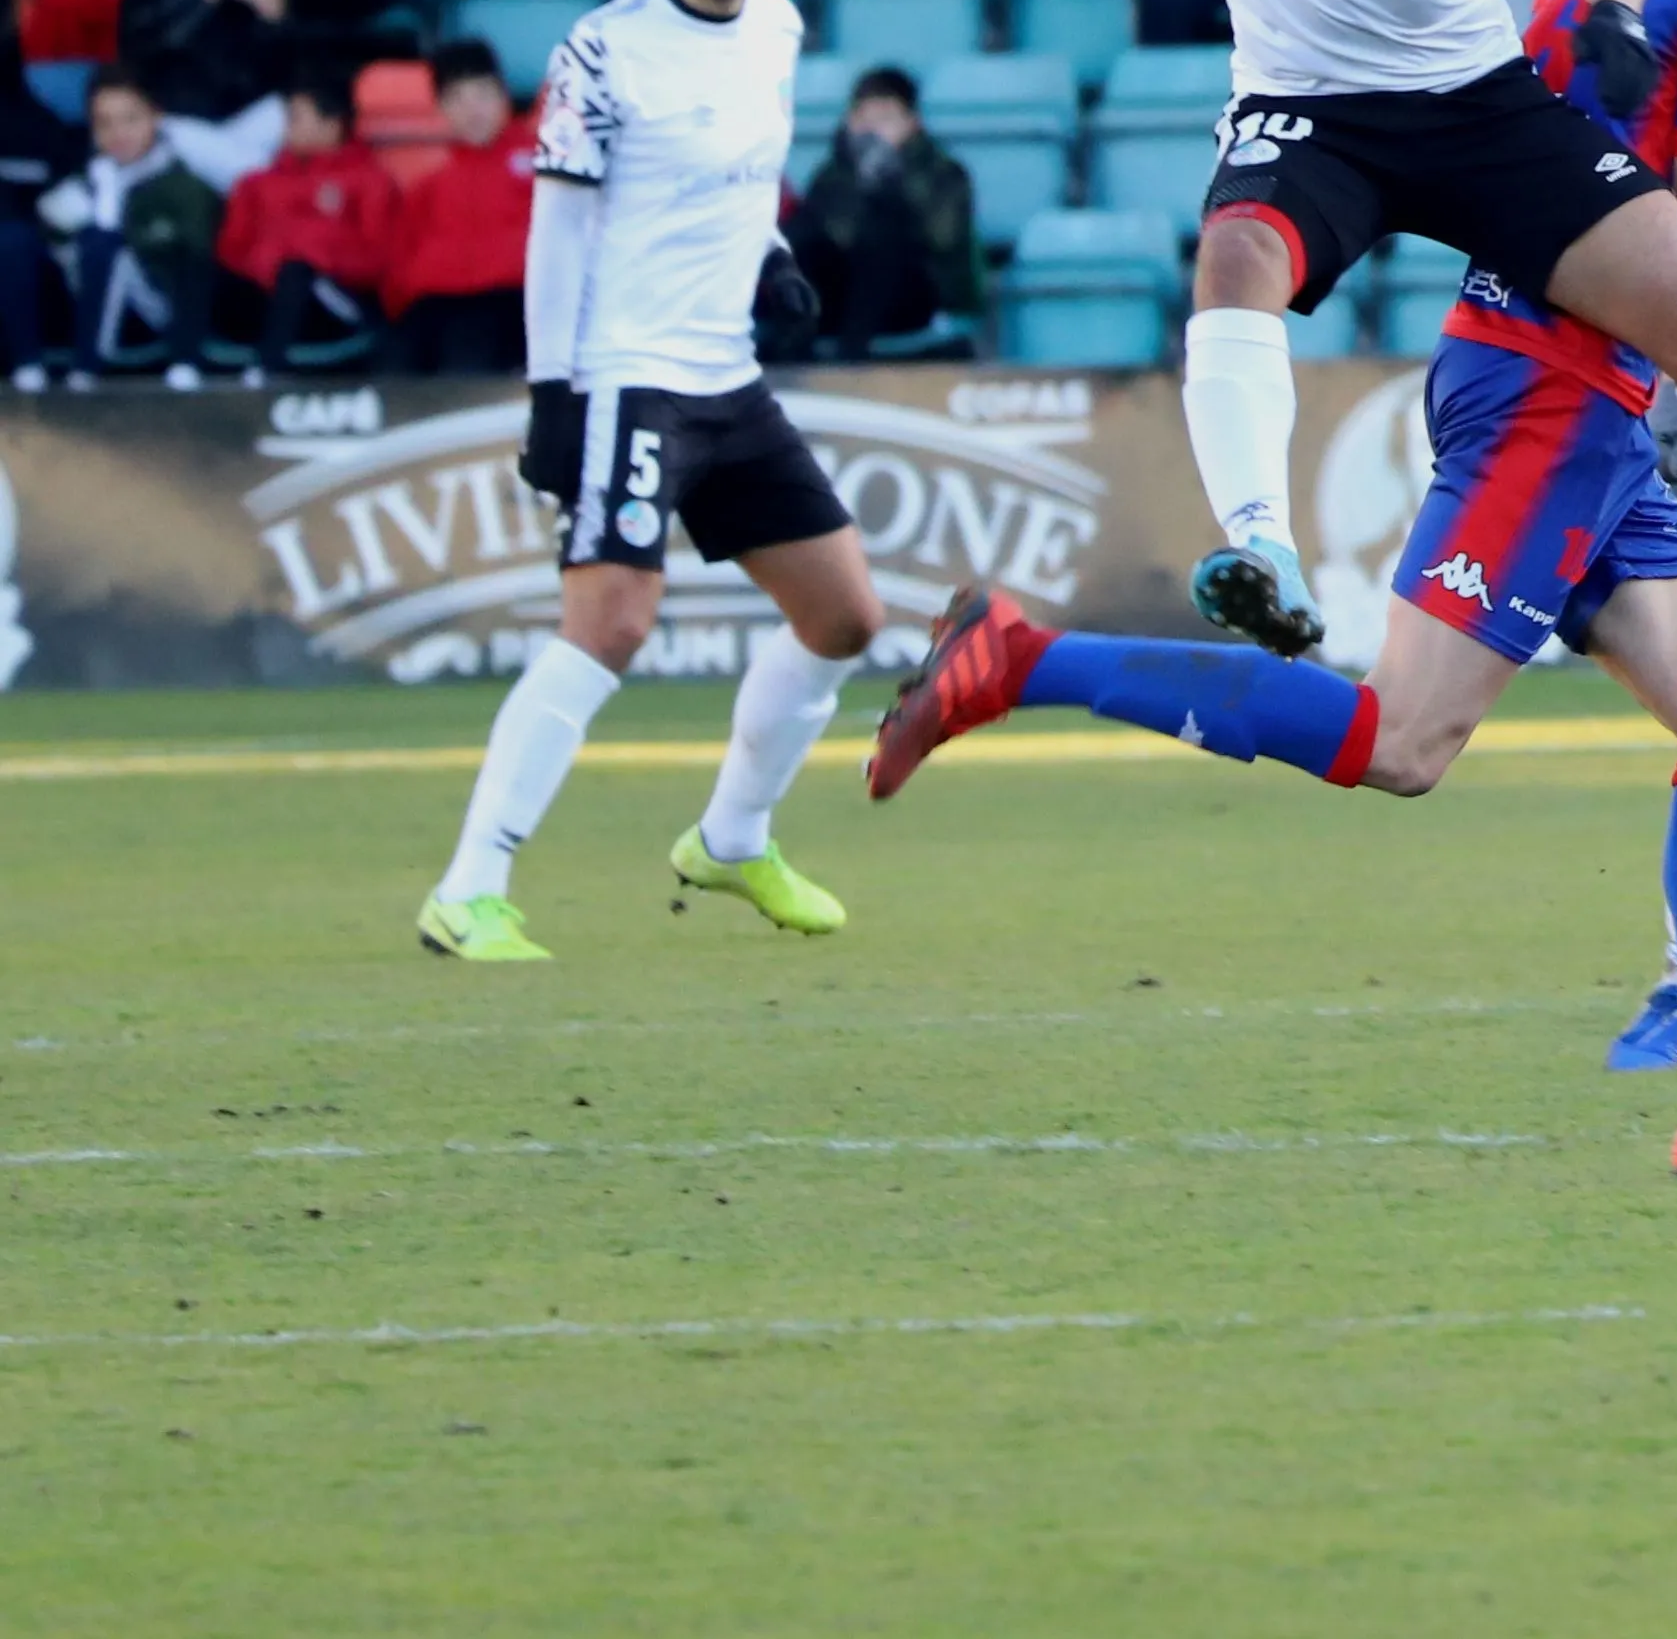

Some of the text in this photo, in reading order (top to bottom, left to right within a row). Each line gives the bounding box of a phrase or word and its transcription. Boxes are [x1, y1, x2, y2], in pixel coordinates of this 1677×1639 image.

[625, 428, 661, 499] 5
[262, 442, 1096, 624] LIVIONE
[1508, 595, 1557, 627] Kapp
